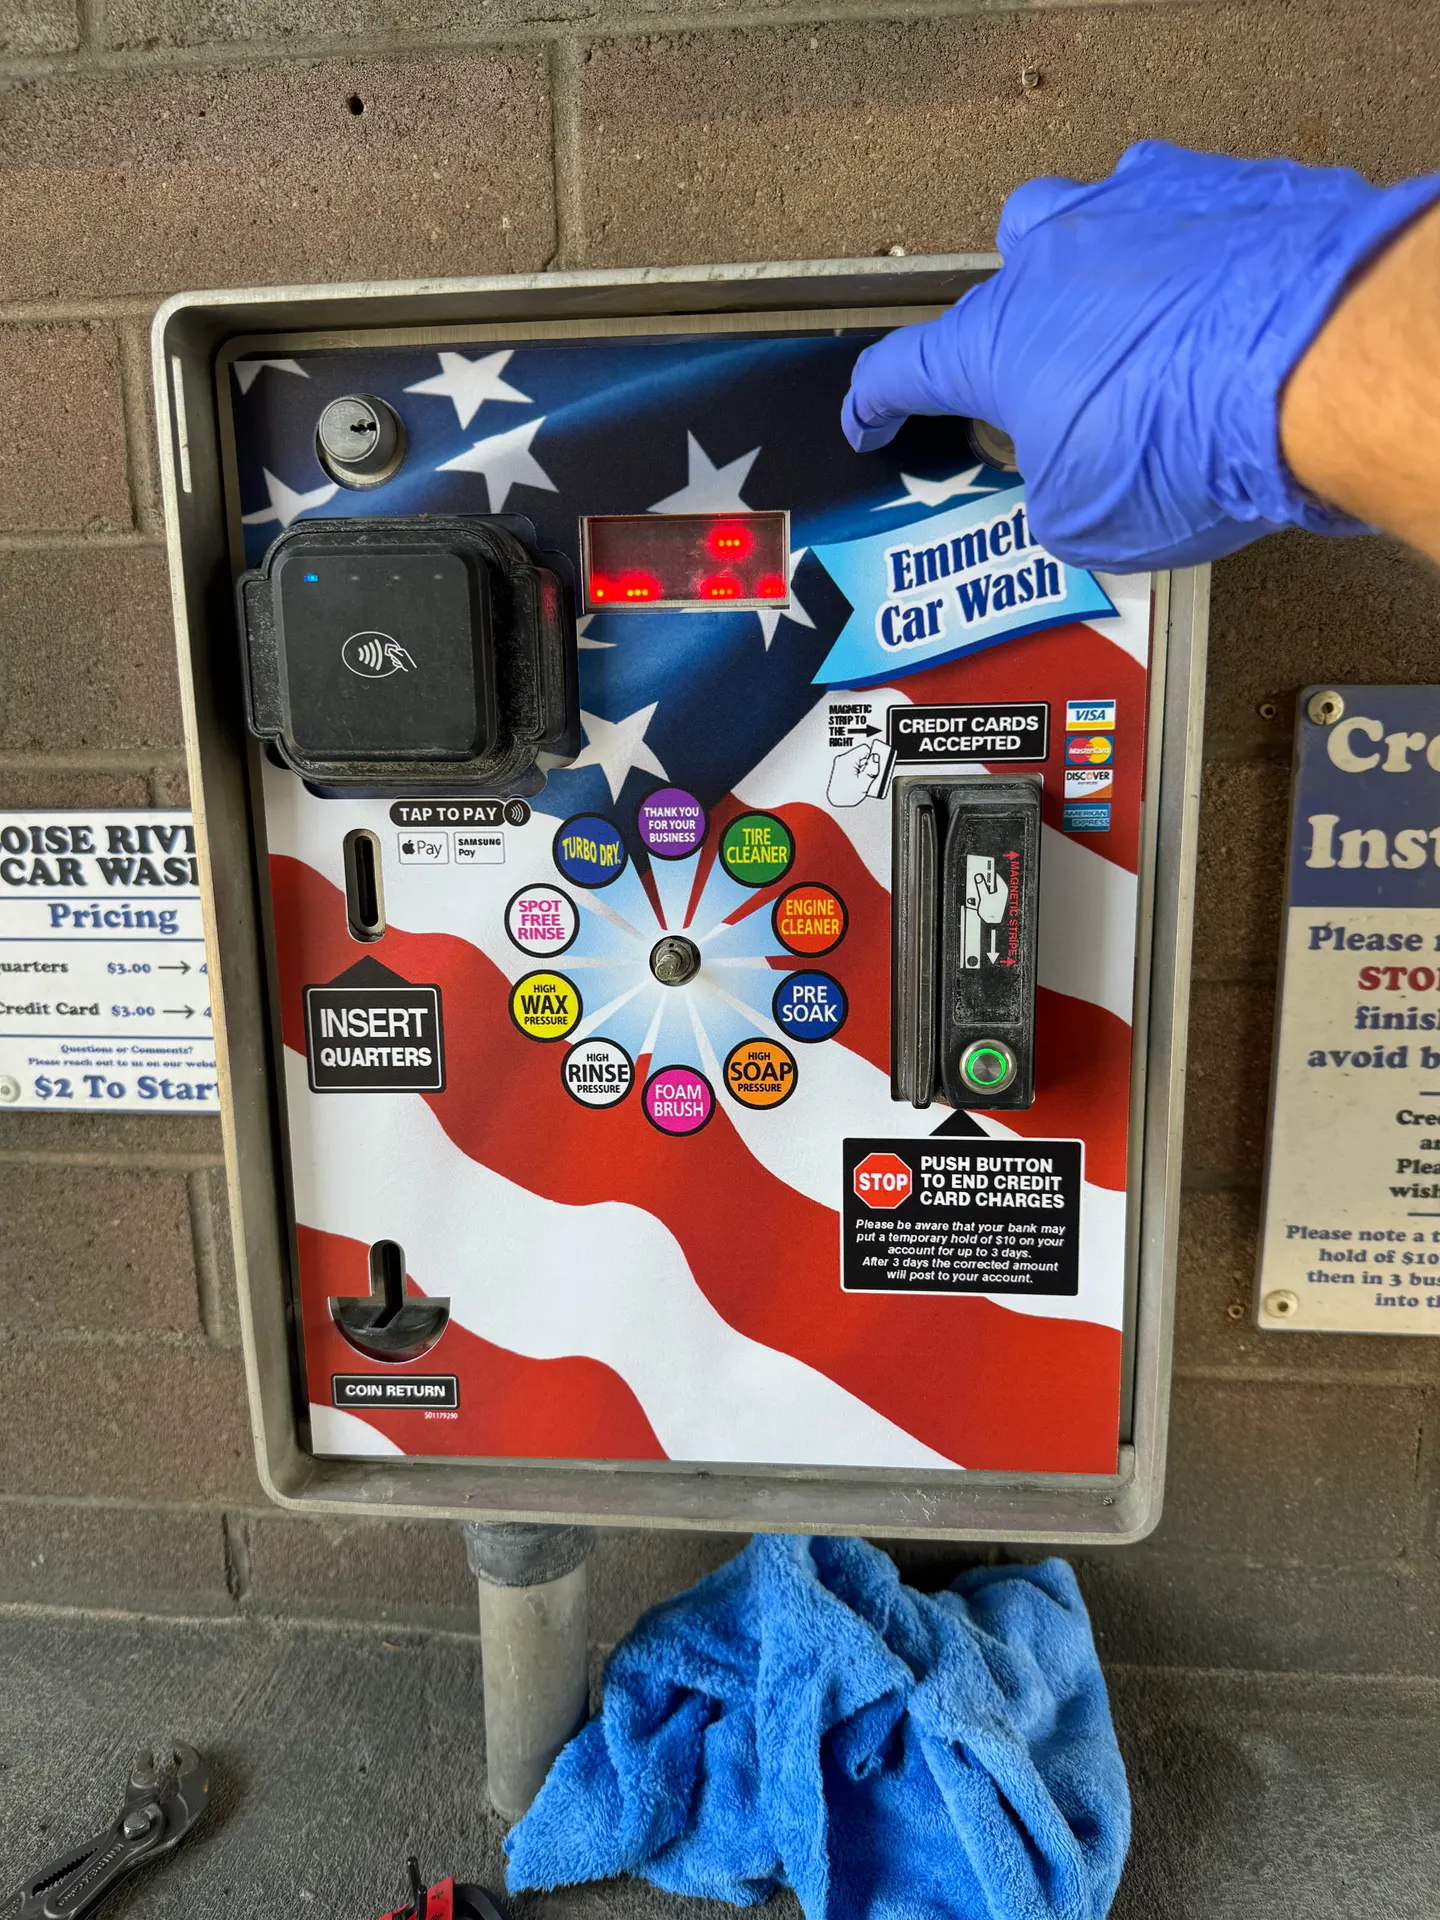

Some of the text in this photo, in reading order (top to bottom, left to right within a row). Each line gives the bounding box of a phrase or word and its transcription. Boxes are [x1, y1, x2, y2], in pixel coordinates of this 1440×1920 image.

[890, 507, 1039, 593] Emmet
[881, 558, 1060, 646] Car Wash
[829, 704, 872, 714] MAGNETIC
[1075, 709, 1106, 721] VISA
[828, 715, 867, 725] STRIP TO
[899, 716, 1039, 734] CREDIT CARDS
[829, 726, 846, 736] THE
[829, 737, 854, 747] RIGHT
[919, 736, 1021, 752] ACCEPTED
[1066, 772, 1110, 781] DISCOVER
[399, 807, 498, 821] TAP TO PAY
[644, 807, 699, 818] THANK YOU
[1064, 810, 1107, 818] AMERICAN
[649, 820, 696, 830] FOR YOUR
[1072, 819, 1110, 827] EXPRESS
[0, 825, 97, 854] OISE
[458, 838, 501, 846] SAMSUNG
[649, 833, 695, 842] BUSINESS
[742, 828, 771, 845] TIRE
[417, 840, 442, 858] Pay
[458, 849, 475, 858] Pay
[562, 836, 597, 864] TURBO
[727, 846, 787, 863] CLEANER
[0, 857, 88, 886] CAR
[519, 900, 562, 913] SPOT
[786, 899, 834, 915] ENGINE
[1008, 861, 1020, 956] MAGNETIC STRIPE
[48, 903, 179, 935] Pricing
[521, 914, 561, 926] FREE
[781, 919, 840, 935] CLEANER
[518, 928, 565, 940] RINSE
[1308, 925, 1423, 951] Please
[0, 961, 69, 975] uarters
[107, 962, 152, 974] $3.00
[1358, 966, 1440, 991] STO
[534, 984, 556, 993] HIGH
[793, 986, 827, 1003] PRE
[56, 1002, 100, 1015] Card
[111, 1004, 155, 1017] $3.00
[521, 995, 569, 1015] WAX
[782, 1004, 837, 1022] SOAK
[320, 1008, 428, 1038] INSERT
[524, 1016, 568, 1025] PRESSURE
[1354, 1005, 1440, 1030] finis
[61, 1044, 113, 1054] Questions
[131, 1046, 193, 1055] Comments?
[320, 1047, 432, 1067] QUARTERS
[586, 1053, 609, 1062] HIGH
[748, 1052, 770, 1061] HIGH
[1307, 1045, 1408, 1069] avoid
[28, 1057, 60, 1066] Please
[64, 1058, 92, 1066] reach
[96, 1059, 113, 1067] out
[117, 1059, 128, 1067] to
[568, 1064, 629, 1083] RINSE
[730, 1062, 793, 1081] SOAP
[35, 1074, 73, 1100] $2
[83, 1075, 126, 1099] To
[577, 1085, 620, 1094] PRESSURE
[655, 1084, 701, 1100] FOAM
[738, 1084, 782, 1092] PRESSURE
[654, 1101, 704, 1117] BRUSH
[1396, 1109, 1440, 1125] Cre
[921, 1156, 1052, 1173] PUSH BUTTON
[859, 1173, 908, 1191] STOP
[921, 1173, 1062, 1191] TO END CREDIT
[920, 1191, 1065, 1208] CARD CHARGES
[855, 1219, 1066, 1235] Please be aware that your bank may
[1286, 1225, 1352, 1240] Please
[1358, 1228, 1406, 1242] note
[1412, 1232, 1424, 1242] a
[856, 1232, 875, 1243] put
[888, 1233, 948, 1245] temporary
[951, 1234, 976, 1245] hold
[980, 1235, 993, 1245] of
[995, 1235, 1016, 1246] $10
[1019, 1238, 1034, 1246] on
[1037, 1237, 1065, 1248] your
[888, 1246, 1032, 1259] account for up to 3 days.
[1319, 1248, 1367, 1263] hold
[1373, 1249, 1396, 1263] of
[862, 1256, 1059, 1272] After 3 days the corrected amount
[887, 1269, 1033, 1284] will post to your account.
[1306, 1269, 1355, 1284] then
[1362, 1271, 1382, 1285] in
[1389, 1273, 1402, 1287] 3
[1375, 1293, 1419, 1307] into
[345, 1384, 446, 1398] COIN RETURN
[424, 1411, 458, 1420] 501179290
